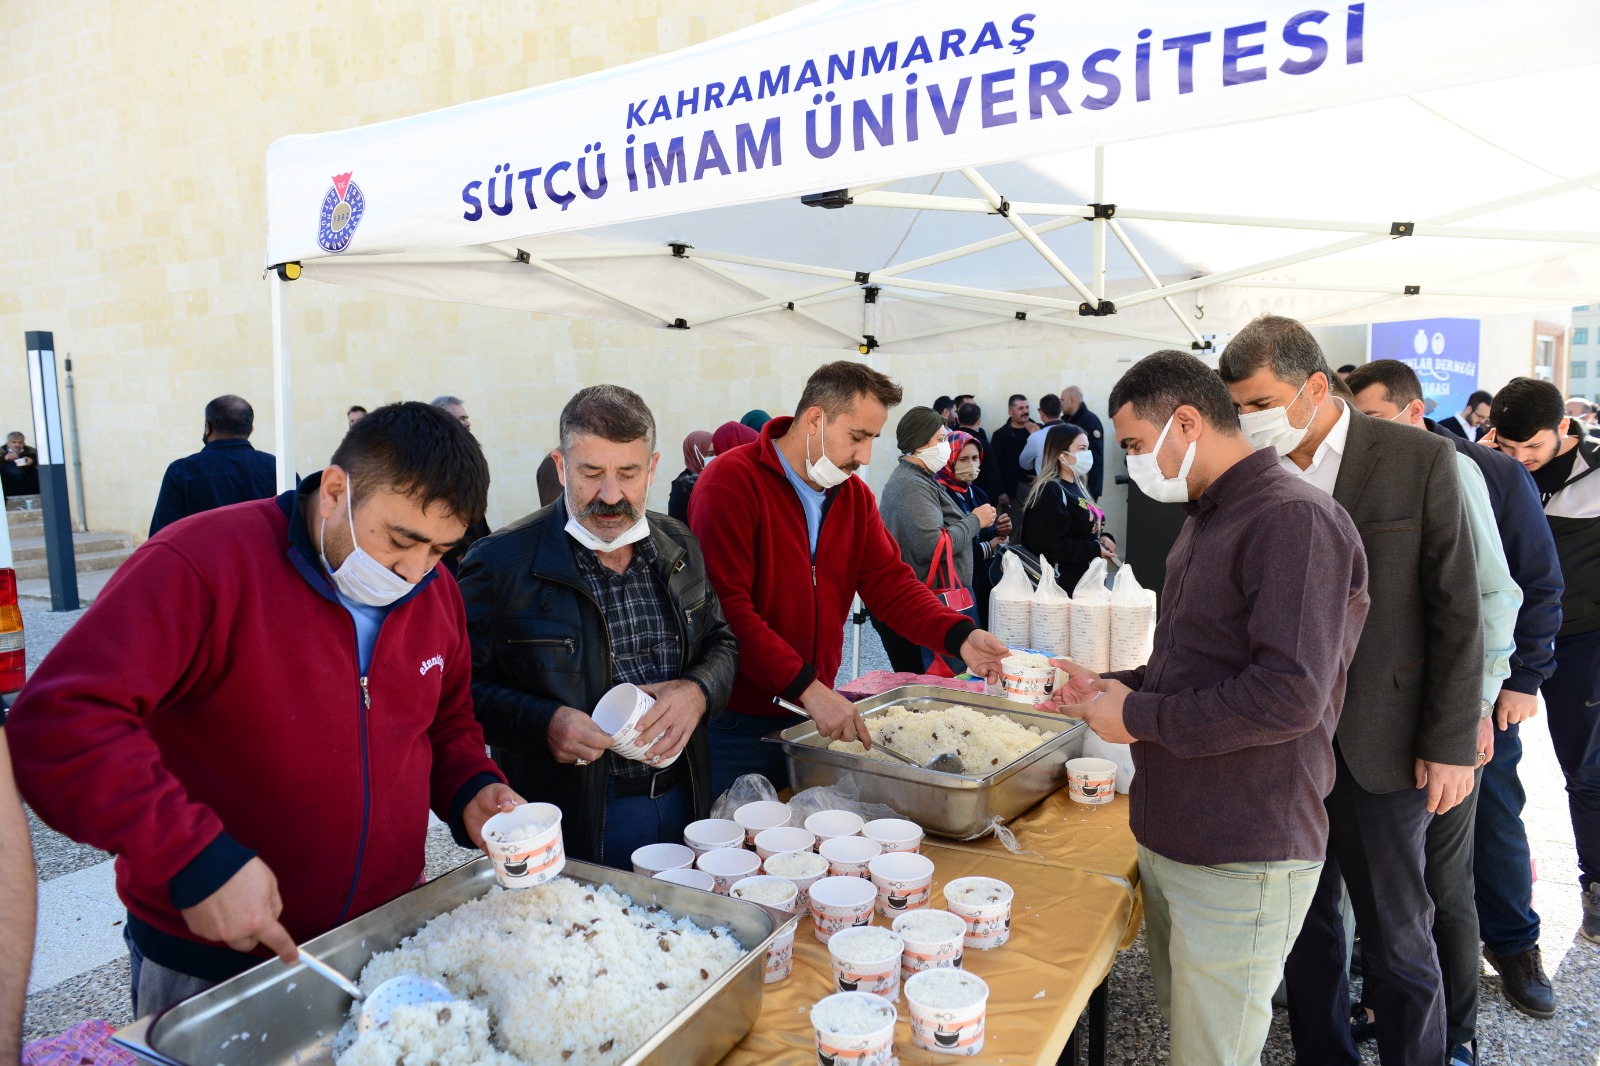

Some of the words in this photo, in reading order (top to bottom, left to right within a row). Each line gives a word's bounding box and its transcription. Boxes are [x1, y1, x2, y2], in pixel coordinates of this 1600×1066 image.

[626, 13, 1036, 130] KAHRAMANMARAŞ
[462, 142, 608, 221] SÜTÇÜ
[625, 117, 782, 192] İMAM
